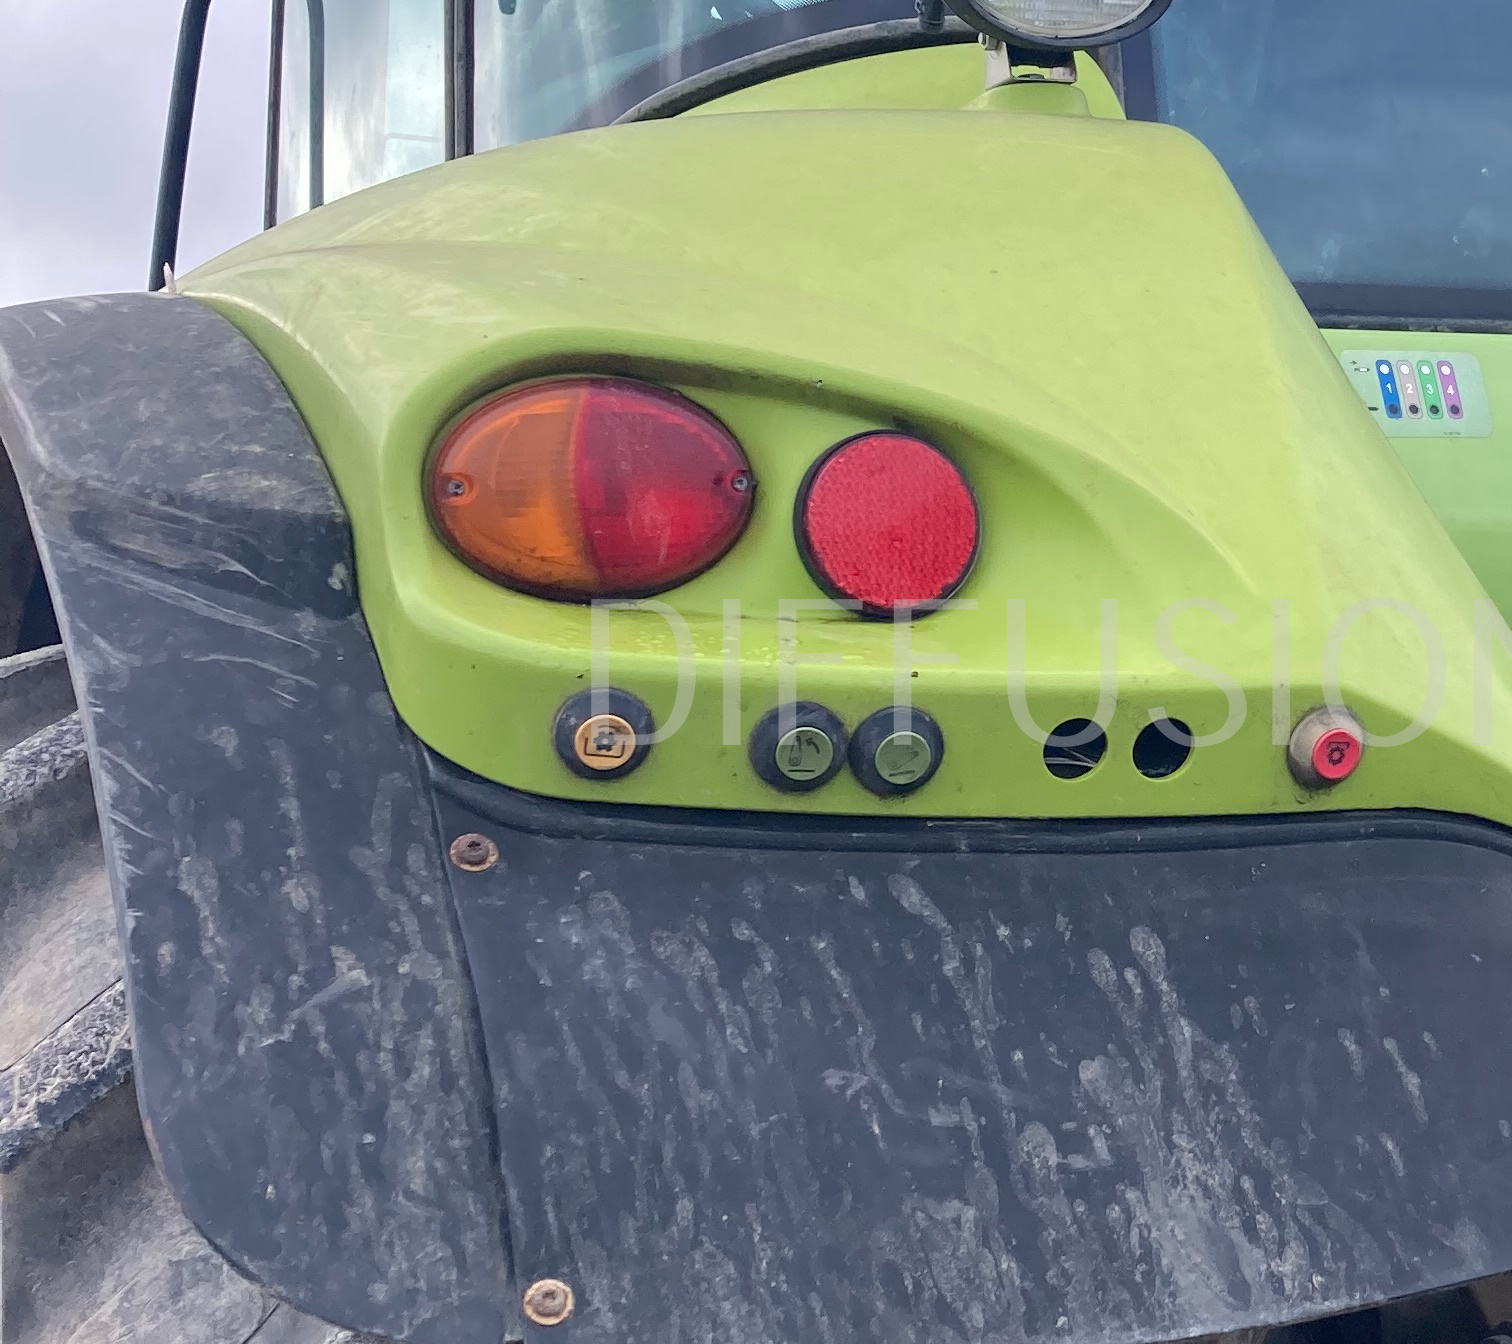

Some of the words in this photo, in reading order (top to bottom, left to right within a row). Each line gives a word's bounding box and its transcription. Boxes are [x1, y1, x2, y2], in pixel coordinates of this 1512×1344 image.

[1385, 382, 1393, 394] 1
[1405, 383, 1414, 394] 2
[1425, 383, 1434, 395] 3
[1446, 384, 1455, 396] 4
